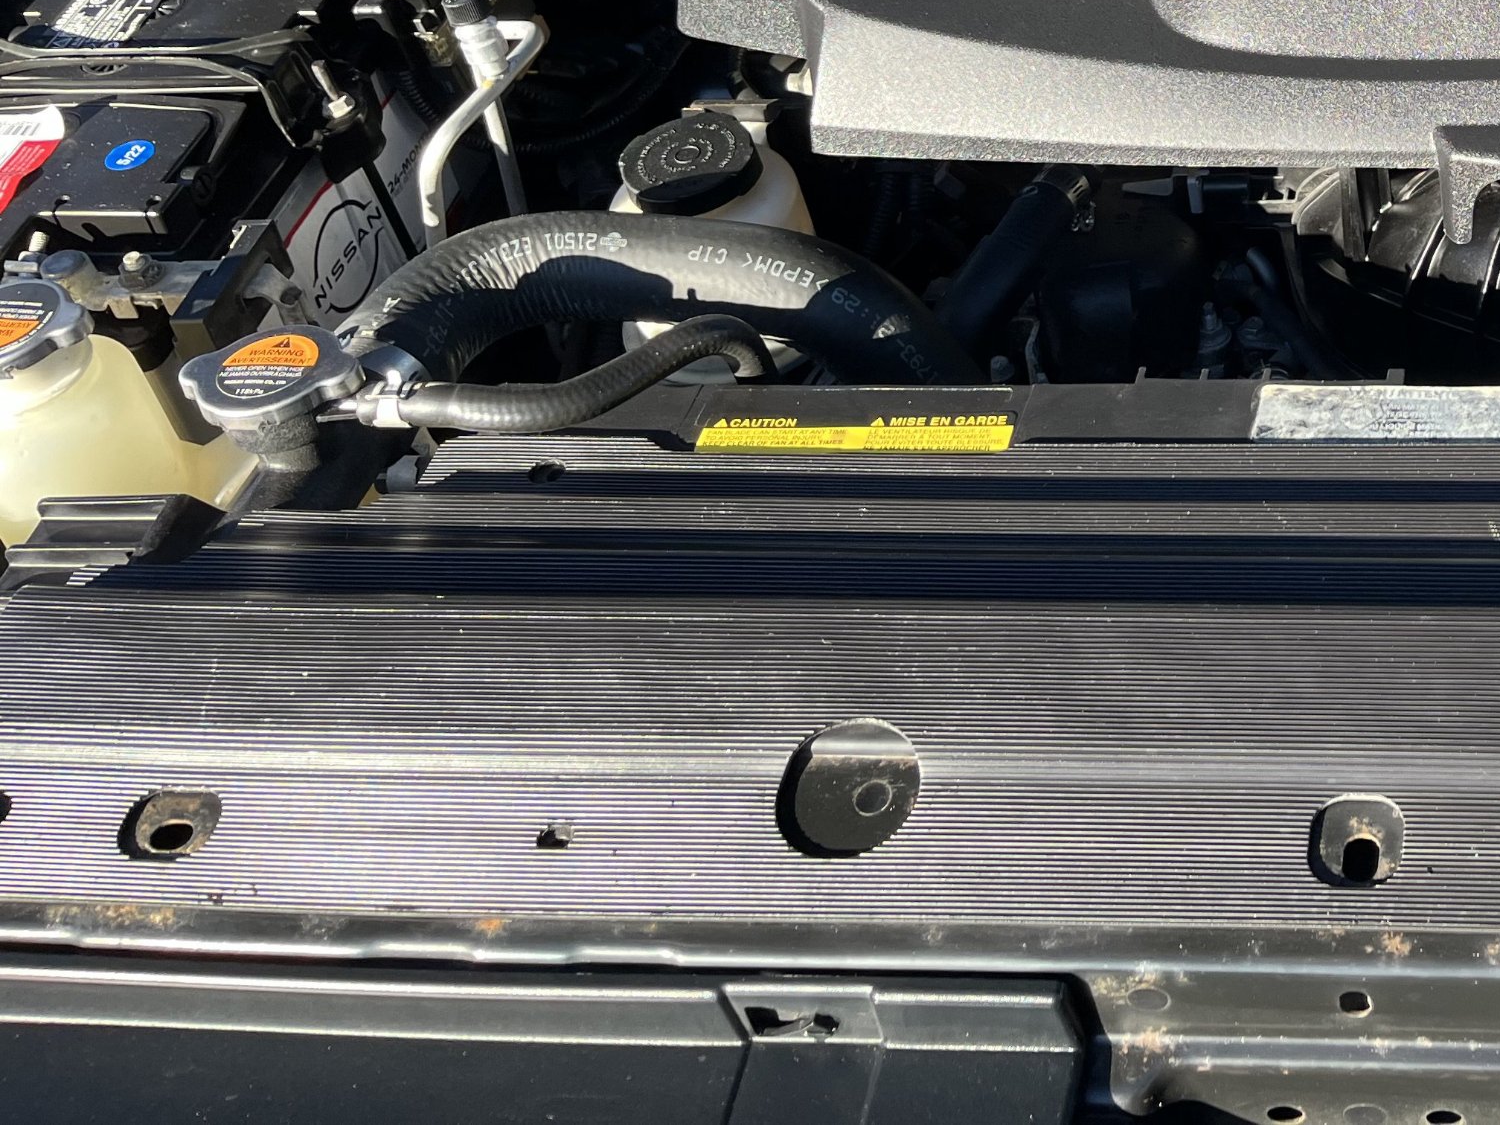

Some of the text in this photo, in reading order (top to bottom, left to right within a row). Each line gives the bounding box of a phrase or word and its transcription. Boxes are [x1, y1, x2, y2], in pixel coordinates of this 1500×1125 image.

[115, 144, 147, 166] 5/22
[544, 232, 598, 251] 21501
[314, 207, 382, 309] NISSAN
[687, 244, 728, 265] CIP
[249, 348, 304, 357] WARNING
[230, 357, 312, 365] AVERTISSEMENT
[729, 417, 798, 428] CAUTION
[889, 415, 1009, 427] MISE EN GARDE
